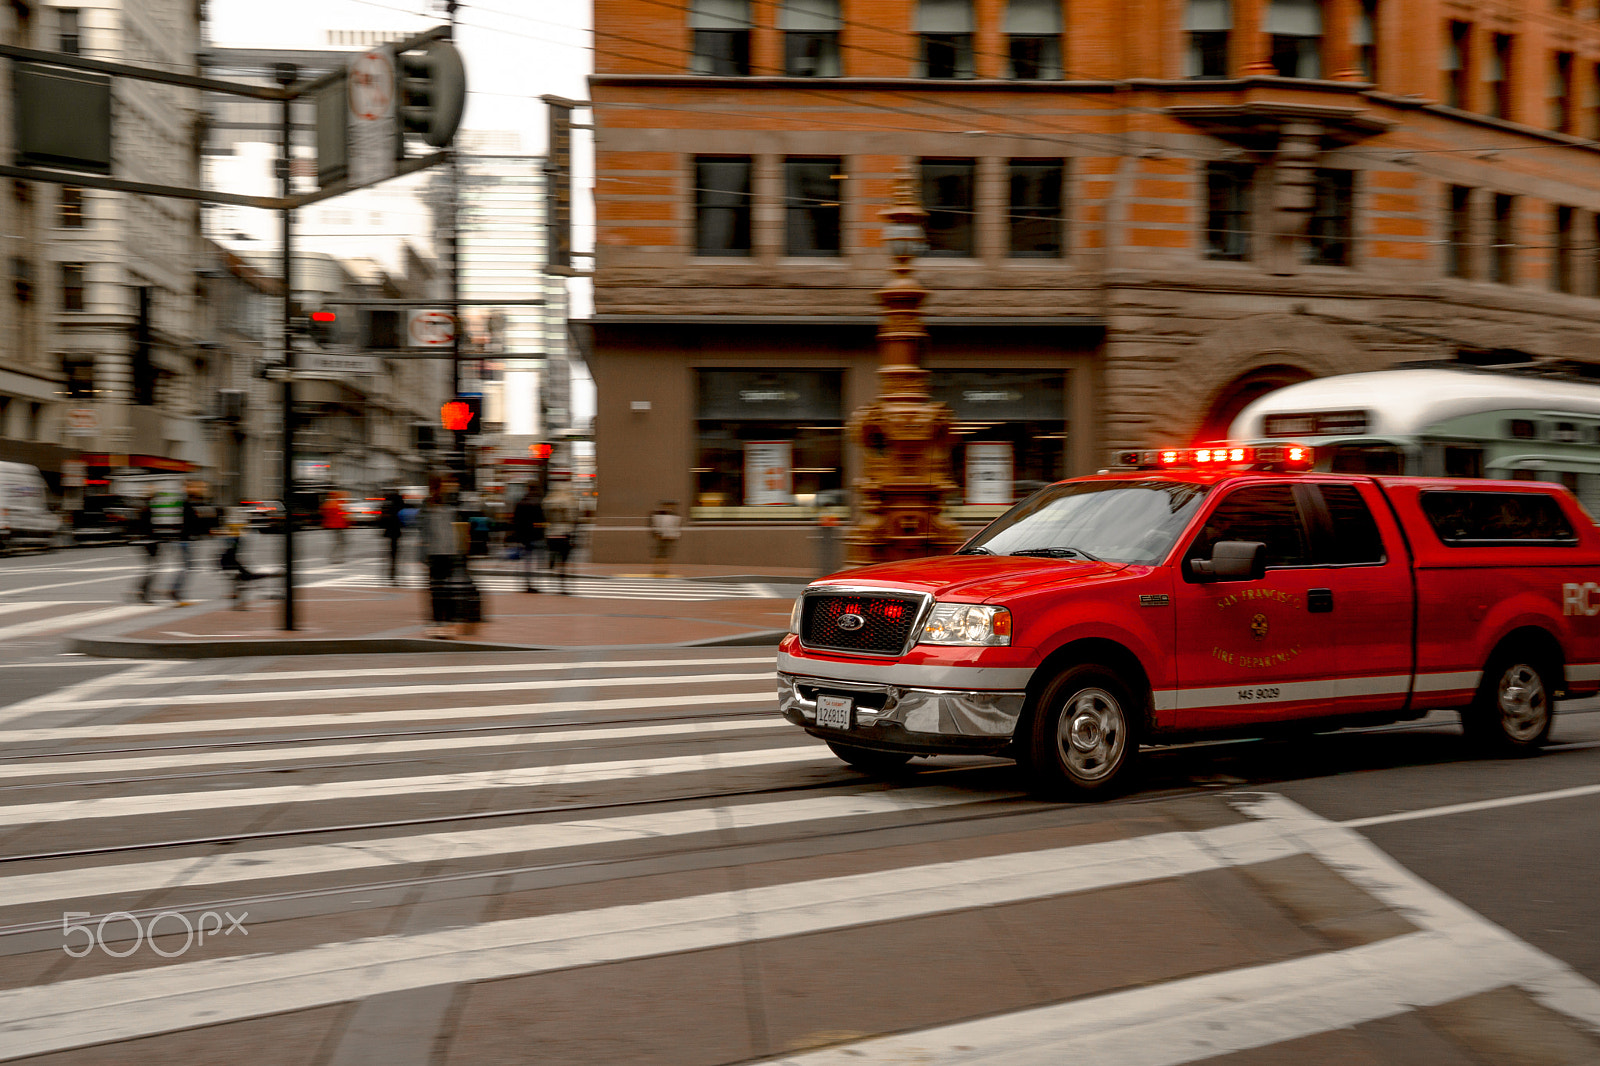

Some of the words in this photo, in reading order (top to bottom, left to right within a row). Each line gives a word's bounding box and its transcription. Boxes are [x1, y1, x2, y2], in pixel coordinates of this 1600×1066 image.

[1217, 594, 1238, 611] SAN
[1241, 589, 1301, 609] FRANCISCO
[1562, 582, 1600, 616] RC
[1212, 646, 1235, 665] FIRE
[1240, 644, 1303, 668] DEPARTMENT
[1238, 689, 1253, 700] 145
